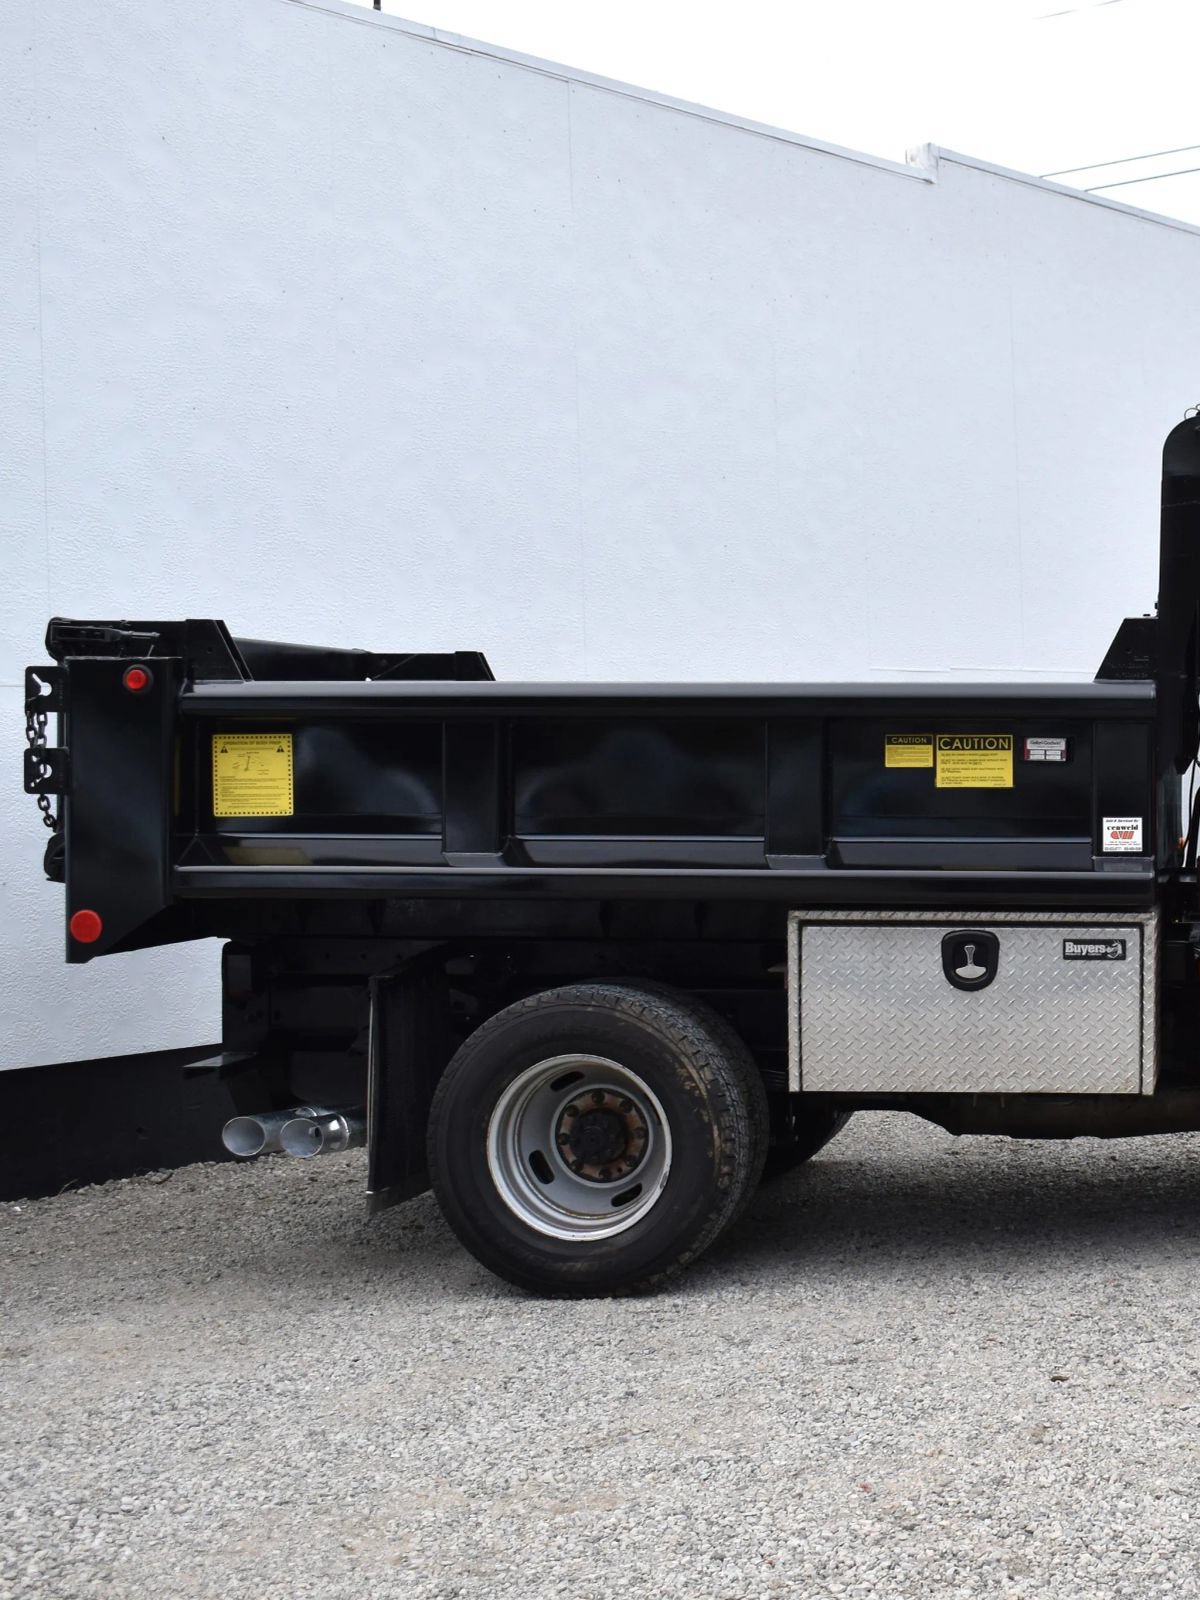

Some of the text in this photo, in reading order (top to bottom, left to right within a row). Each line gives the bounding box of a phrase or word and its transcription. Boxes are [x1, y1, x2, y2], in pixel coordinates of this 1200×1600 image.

[891, 736, 928, 744] CAUTION
[940, 738, 1009, 750] CAUTION
[1064, 941, 1106, 956] Buyers
